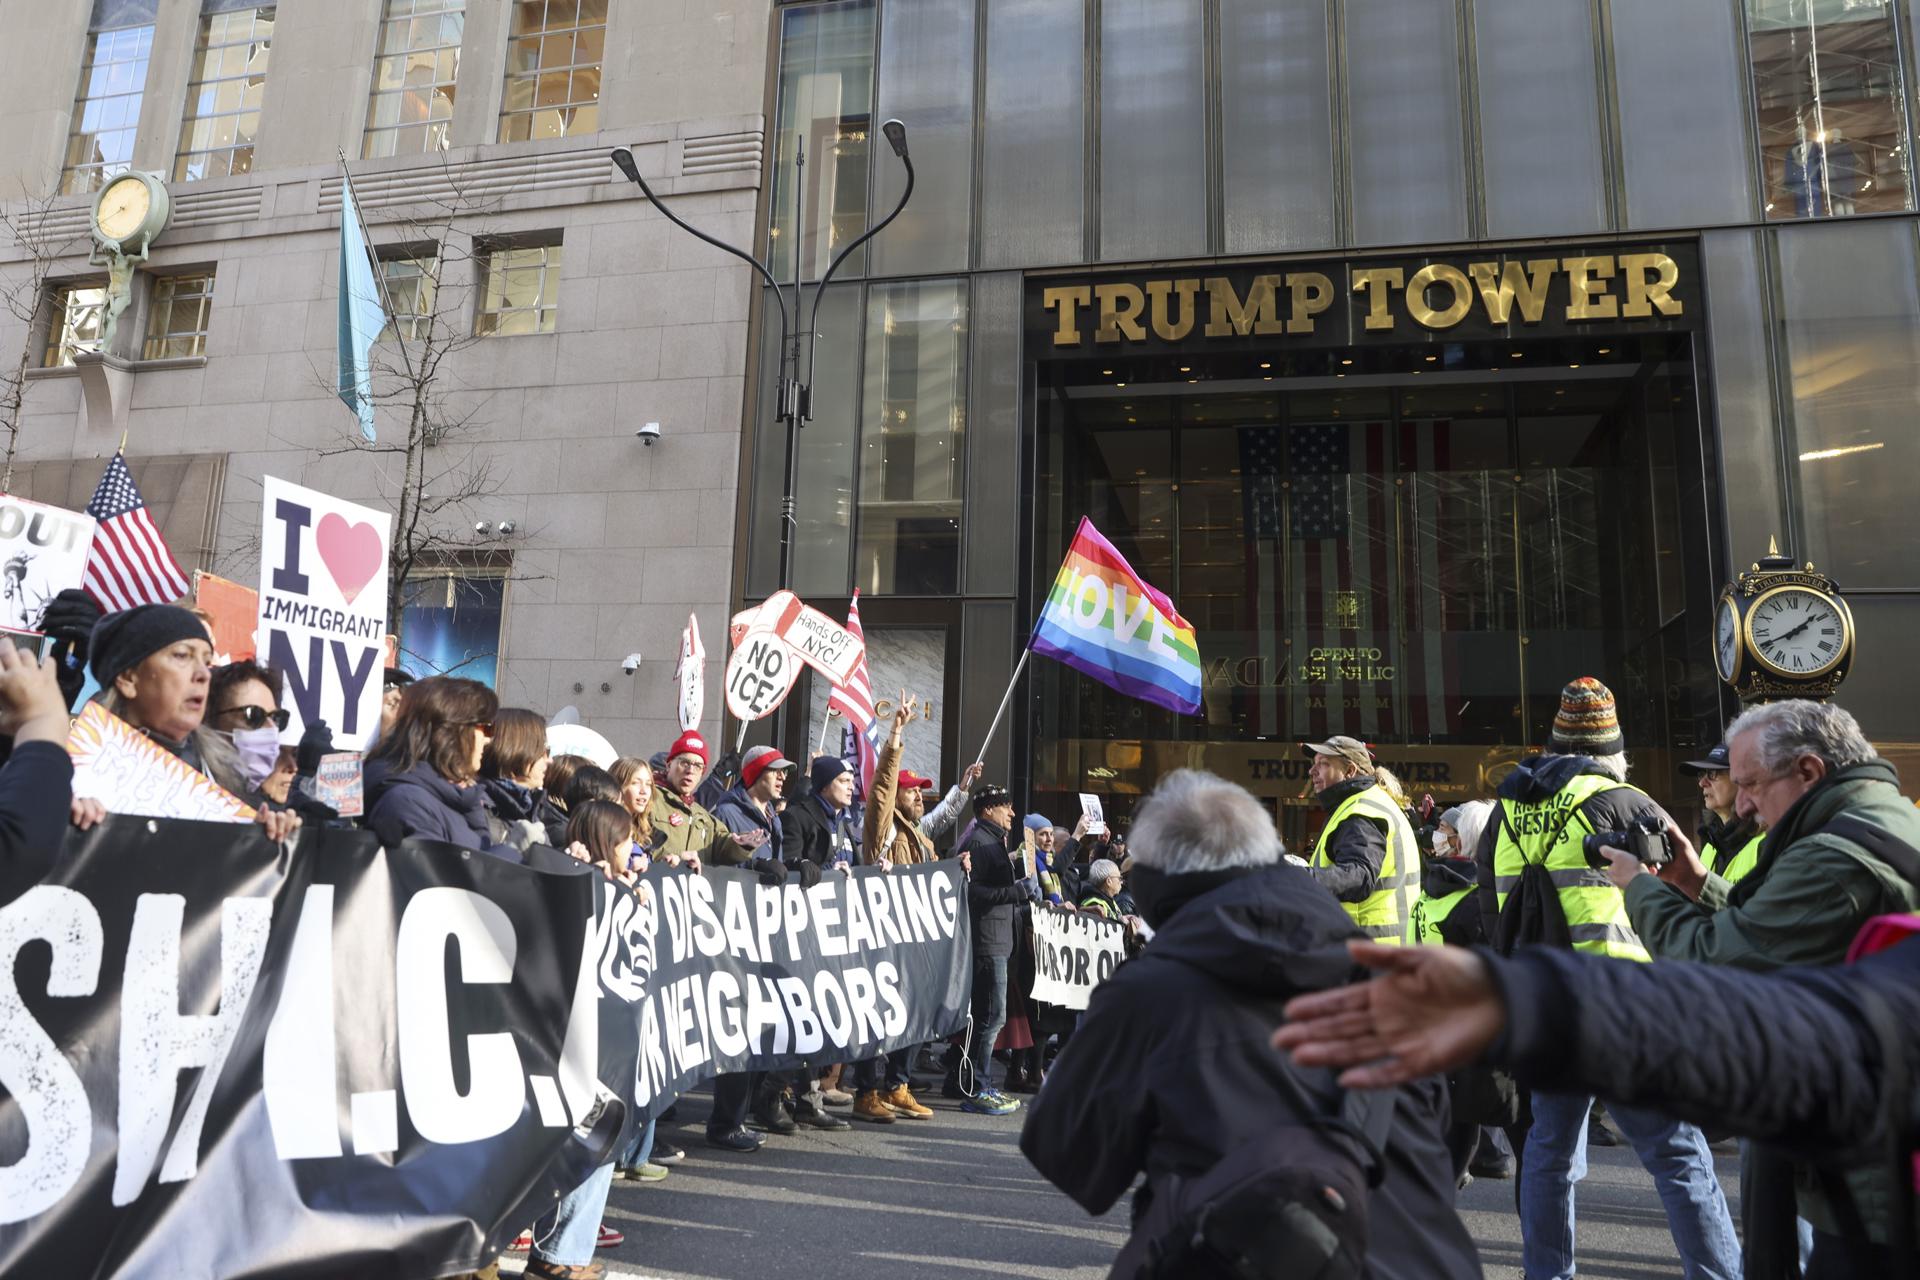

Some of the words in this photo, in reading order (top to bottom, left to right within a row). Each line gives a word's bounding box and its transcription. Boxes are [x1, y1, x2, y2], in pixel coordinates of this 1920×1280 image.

[1043, 272, 1335, 347] TRUMP
[1352, 252, 1684, 332] TOWER
[272, 498, 312, 595] I
[1758, 574, 1789, 590] TRUMP
[1791, 574, 1825, 589] TOWER
[263, 597, 383, 640] IMMIGRANT
[796, 611, 829, 641] Hands
[1057, 566, 1179, 664] LOVE
[746, 640, 783, 679] NO
[802, 635, 842, 666] NYC!
[1310, 647, 1356, 661] OPEN
[1358, 647, 1383, 661] TO
[268, 628, 380, 735] NY
[729, 666, 785, 714] ICE!
[1513, 808, 1570, 838] RESIST
[662, 868, 958, 965] DISAPPEARING
[660, 960, 908, 1080] NEIGHBORS
